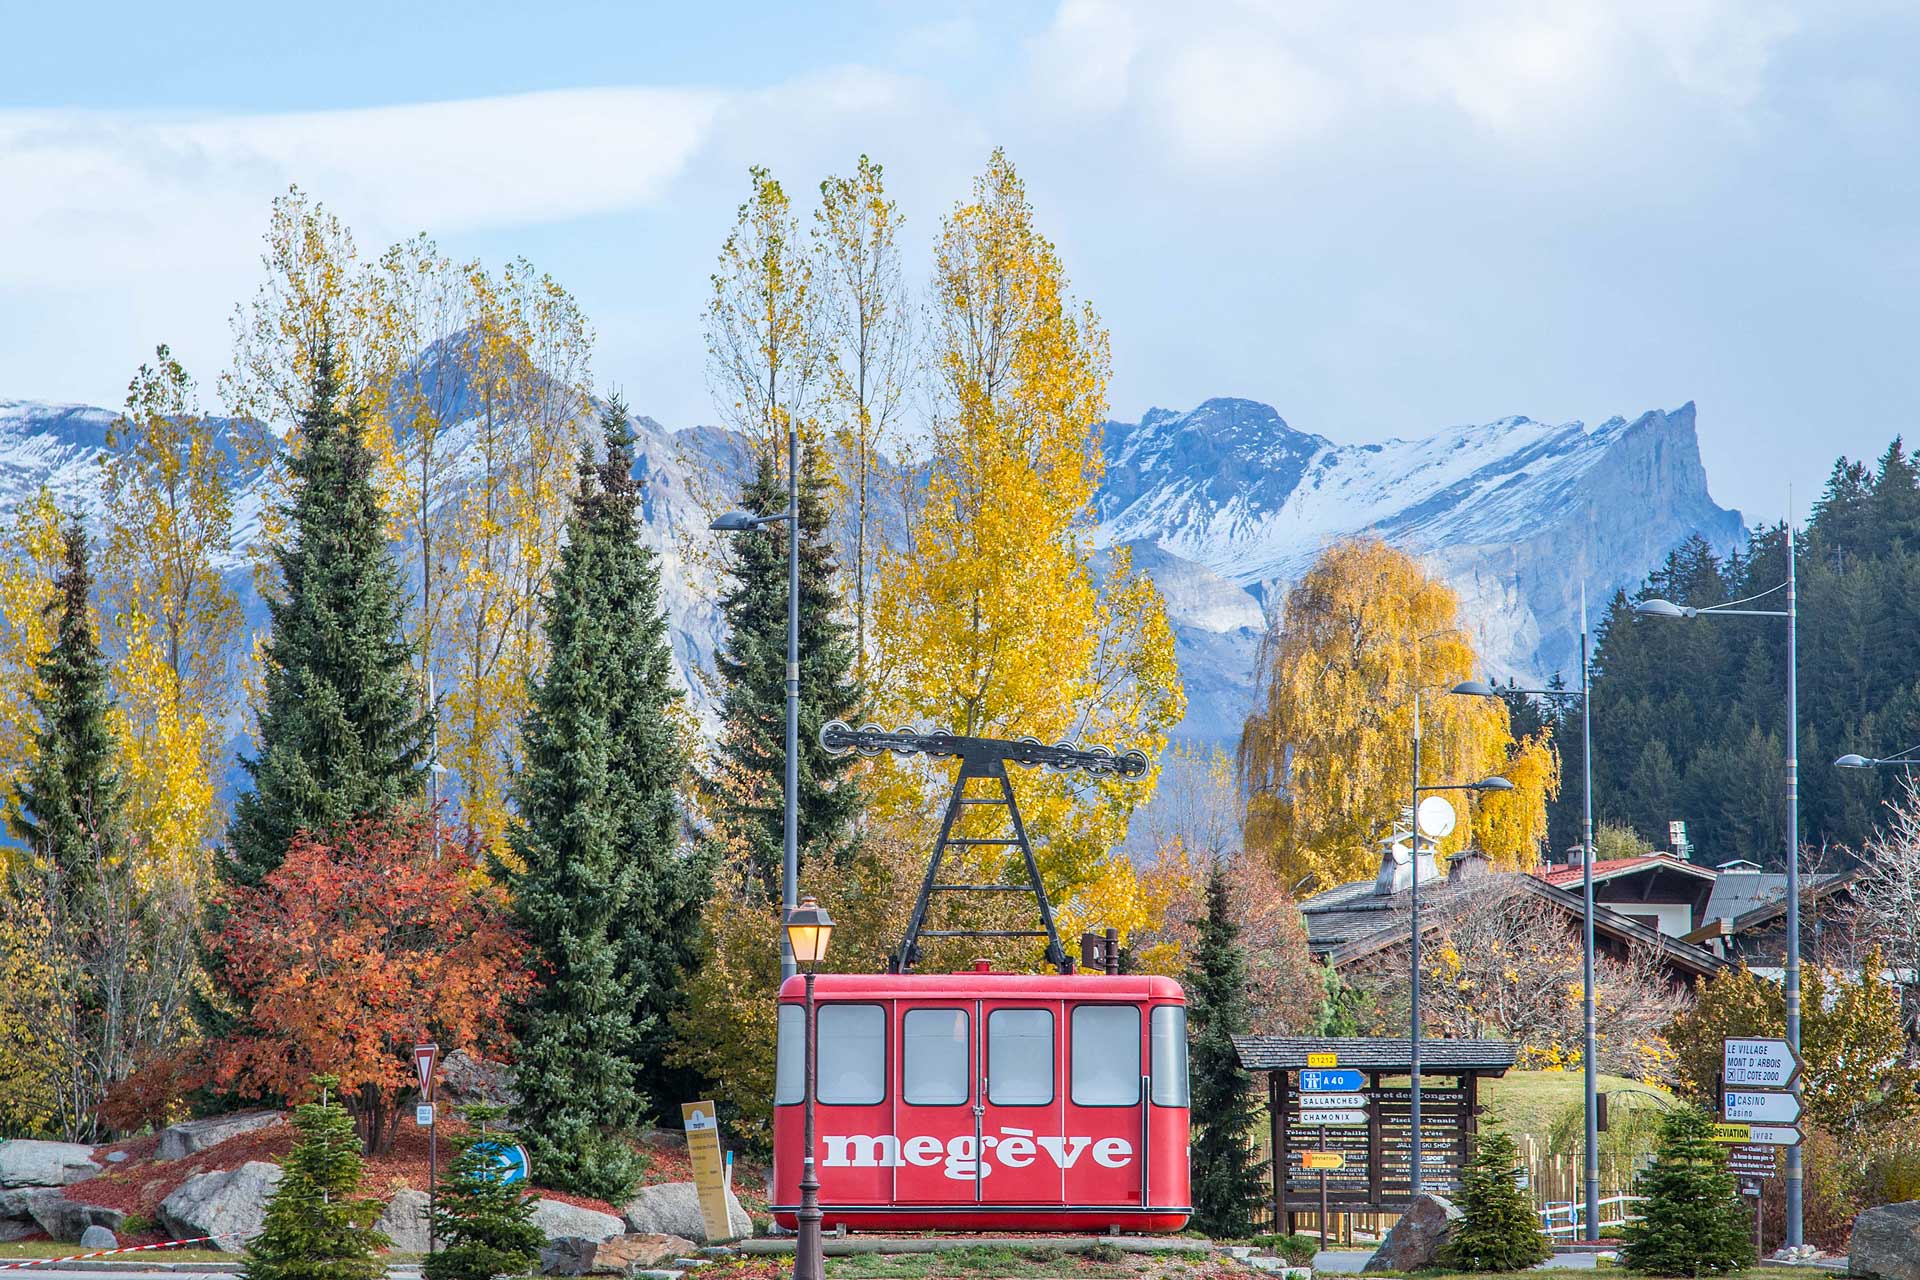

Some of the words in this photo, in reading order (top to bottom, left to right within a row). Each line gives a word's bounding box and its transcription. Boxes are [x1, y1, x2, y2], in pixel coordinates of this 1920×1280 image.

[1727, 1044, 1736, 1054] LE
[1738, 1045, 1768, 1055] VILLAGE
[1727, 1057, 1747, 1067] MONT
[1323, 1076, 1330, 1085] A
[1331, 1076, 1344, 1085] 40
[1763, 1071, 1779, 1081] 2000
[1303, 1097, 1359, 1105] SALLANCHES
[1737, 1096, 1766, 1106] CASINO
[1727, 1107, 1753, 1118] Casino
[1750, 1130, 1773, 1140] ivraz
